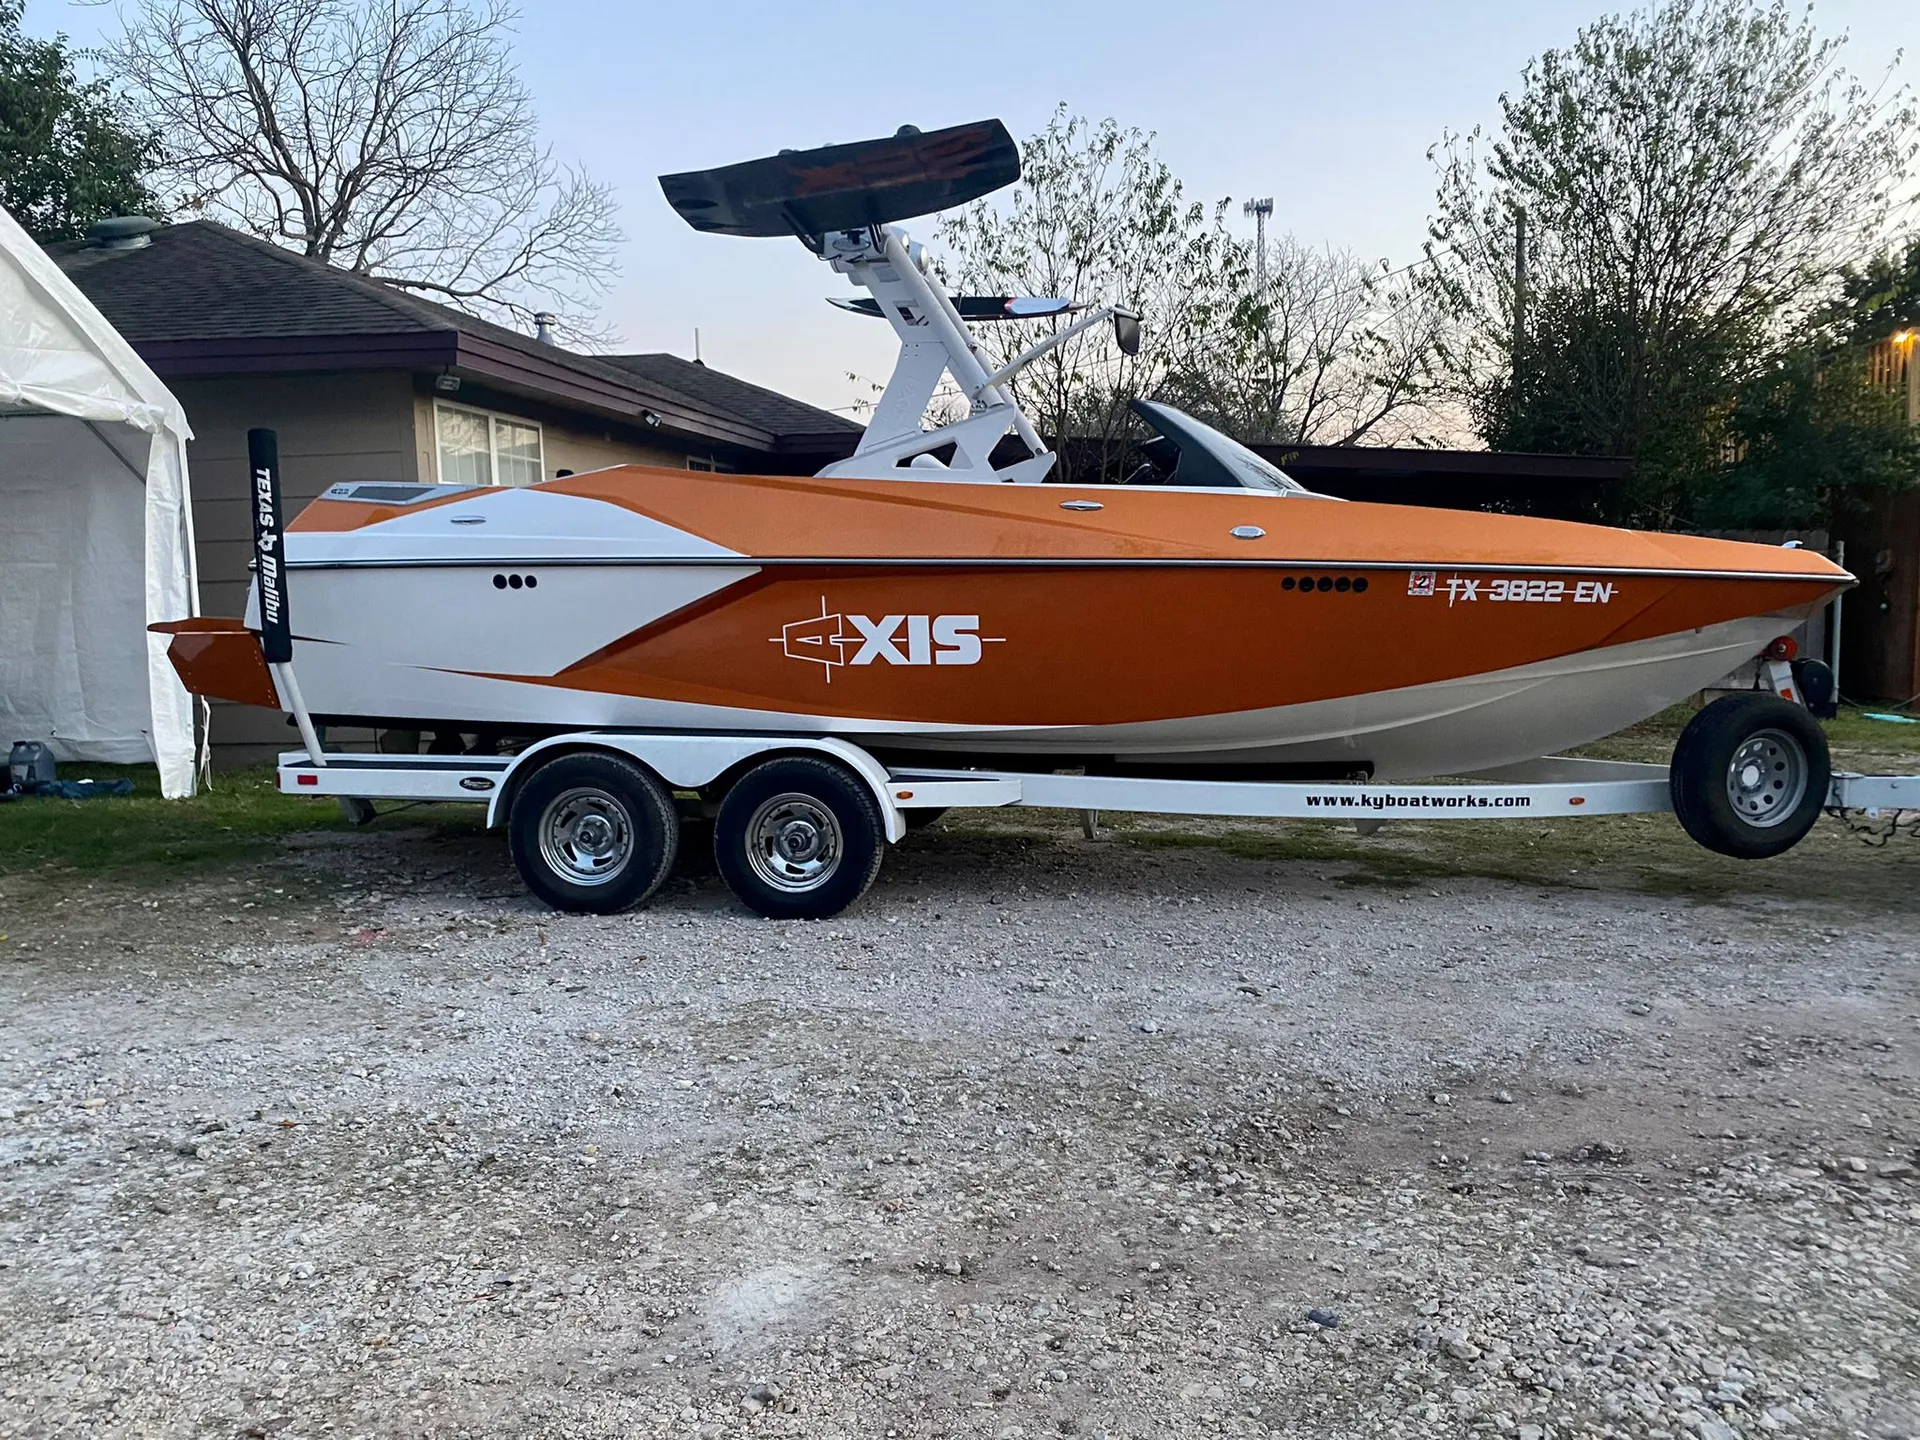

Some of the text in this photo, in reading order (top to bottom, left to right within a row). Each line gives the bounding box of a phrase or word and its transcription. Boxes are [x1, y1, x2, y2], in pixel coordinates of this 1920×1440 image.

[256, 468, 274, 527] TEXAS
[1446, 578, 1613, 603] TX 3822 EN
[782, 613, 982, 667] AXIS
[1306, 794, 1531, 810] www.kyboatworks.com
